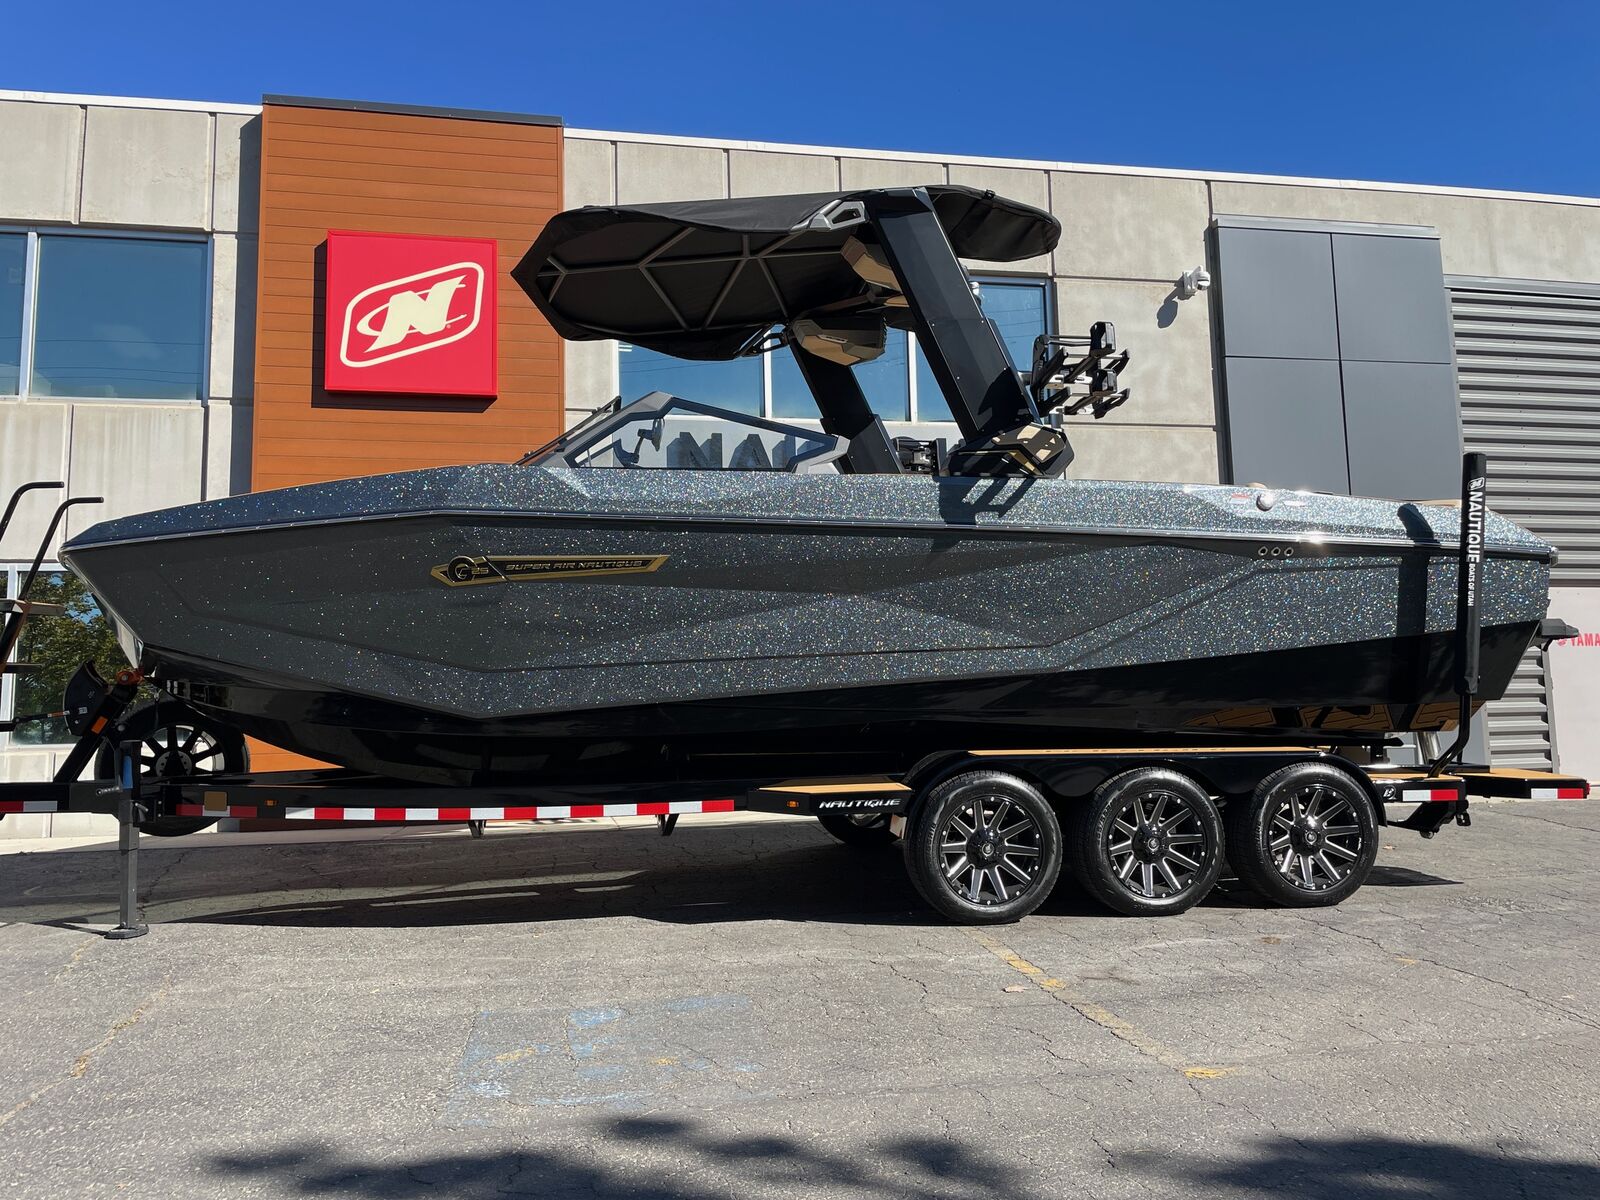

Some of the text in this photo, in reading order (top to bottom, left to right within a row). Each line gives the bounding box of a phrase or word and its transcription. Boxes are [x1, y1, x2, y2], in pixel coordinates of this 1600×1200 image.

[1466, 491, 1484, 563] NAUTIQUE
[505, 563, 551, 571] SUPER
[578, 560, 643, 569] NAUTIQUE
[1468, 563, 1476, 582] BOATS
[1467, 591, 1475, 607] UTAH
[819, 798, 902, 809] NAUTIQUE
